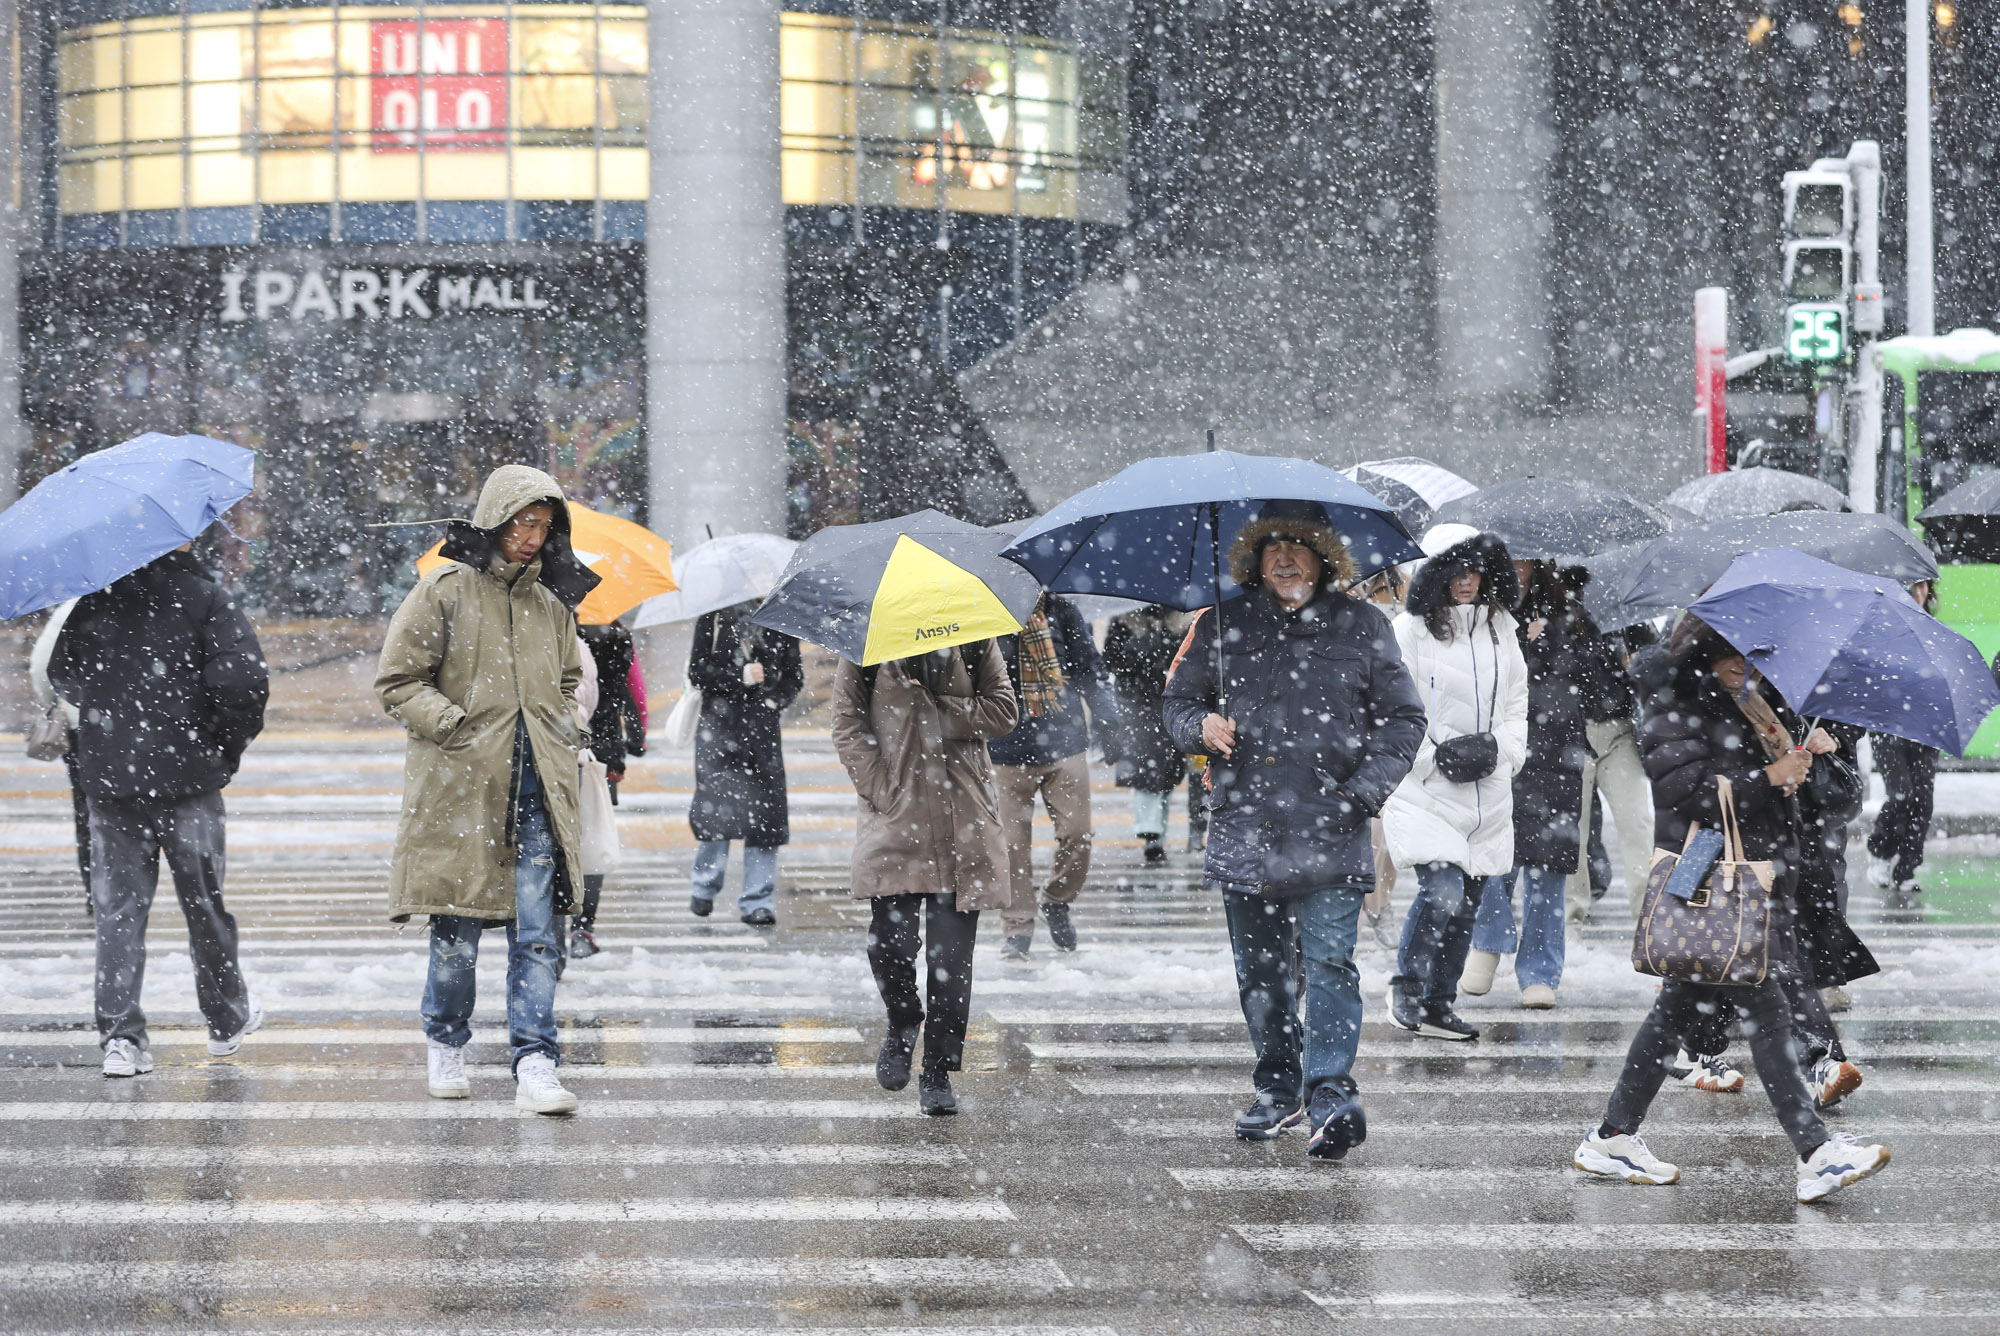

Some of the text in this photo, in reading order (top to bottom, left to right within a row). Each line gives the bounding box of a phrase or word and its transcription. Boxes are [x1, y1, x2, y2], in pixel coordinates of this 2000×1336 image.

[382, 32, 481, 74] UNI
[438, 275, 547, 309] MALL
[1789, 310, 1839, 358] 25
[915, 623, 959, 641] Ansys
